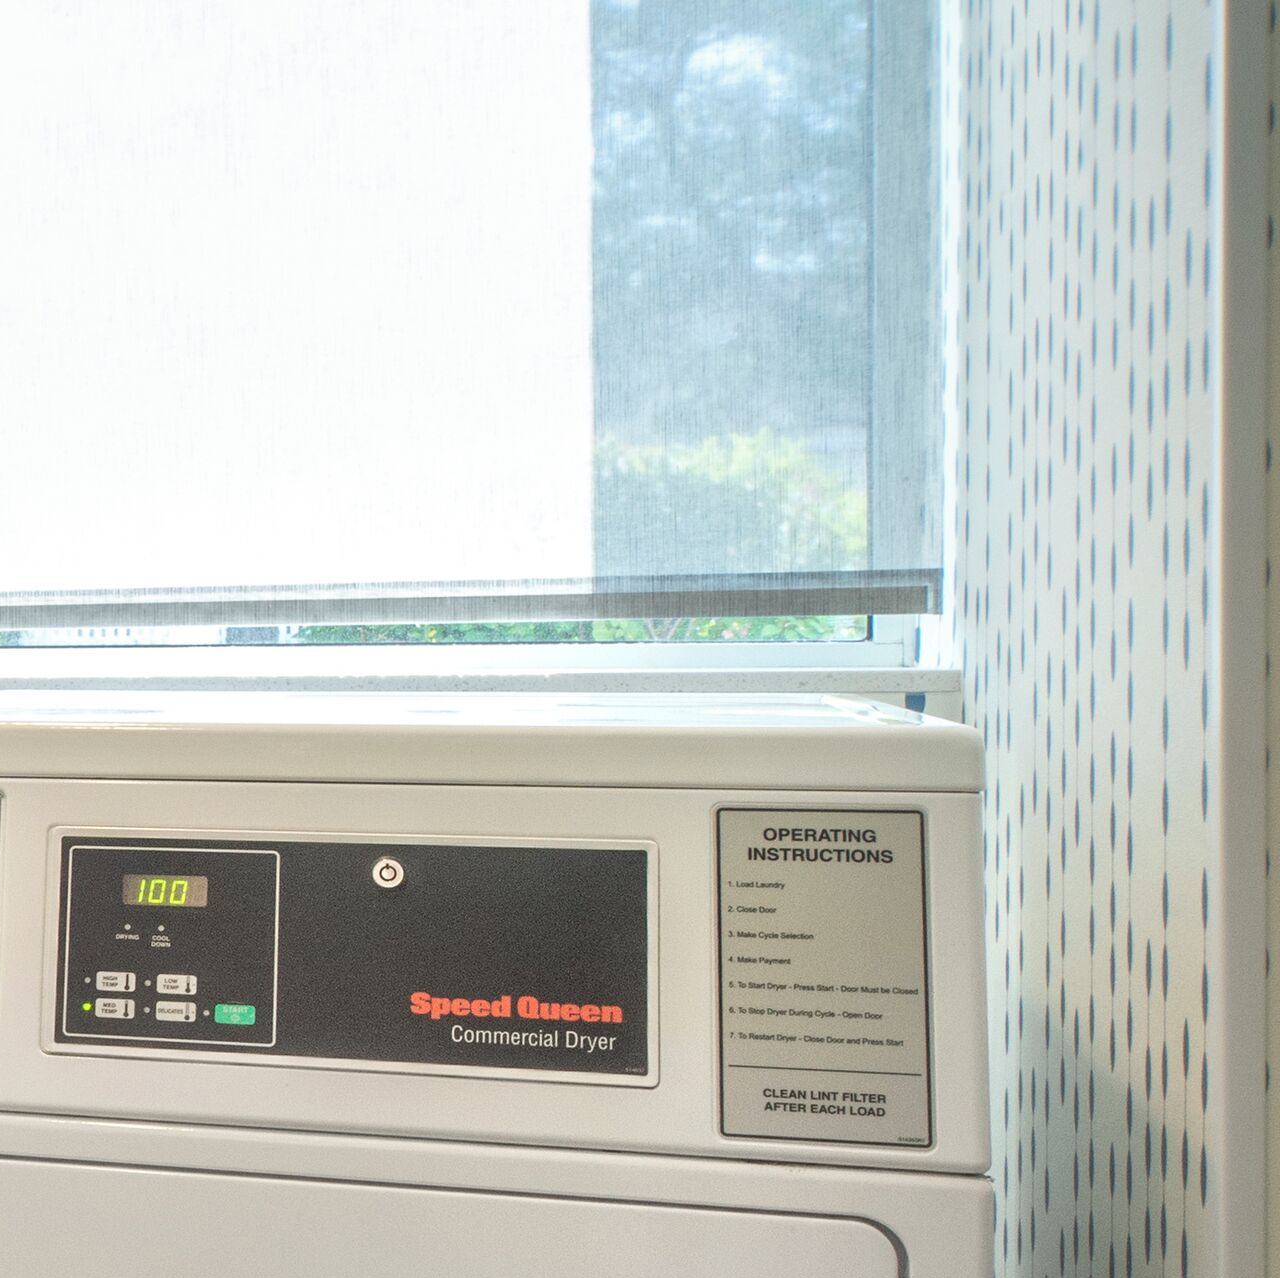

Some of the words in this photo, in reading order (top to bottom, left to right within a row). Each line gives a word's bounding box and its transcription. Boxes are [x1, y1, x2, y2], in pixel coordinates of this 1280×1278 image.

[763, 828, 877, 843] OPERATING
[747, 847, 894, 863] INSTRUCTIONS
[138, 879, 188, 905] 100
[756, 881, 785, 890] Laundry
[115, 933, 140, 941] DRYING
[758, 932, 779, 940] Cycle
[780, 932, 814, 940] Selection
[759, 957, 791, 965] Payment
[767, 983, 787, 991] Dryer
[817, 984, 834, 992] Start
[840, 985, 859, 993] Door
[222, 1006, 248, 1014] START
[410, 991, 512, 1020] Speed
[517, 995, 623, 1024] Queen
[748, 1008, 765, 1016] Stop
[767, 1008, 787, 1017] Dryer
[789, 1009, 813, 1018] During
[815, 1010, 835, 1019] Cycle
[842, 1011, 863, 1020] Open
[451, 1024, 559, 1049] Commercial
[565, 1031, 617, 1053] Dryer
[749, 1033, 775, 1041] Restart
[776, 1034, 797, 1043] Dryer
[804, 1035, 825, 1043] Close
[862, 1038, 884, 1046] Press
[886, 1039, 903, 1047] Start
[763, 1088, 807, 1099] CLEAN
[810, 1091, 839, 1101] LINT
[842, 1092, 886, 1104] FILTER
[764, 1102, 806, 1113] AFTER
[810, 1104, 846, 1115] EACH
[850, 1106, 886, 1117] LOAD
